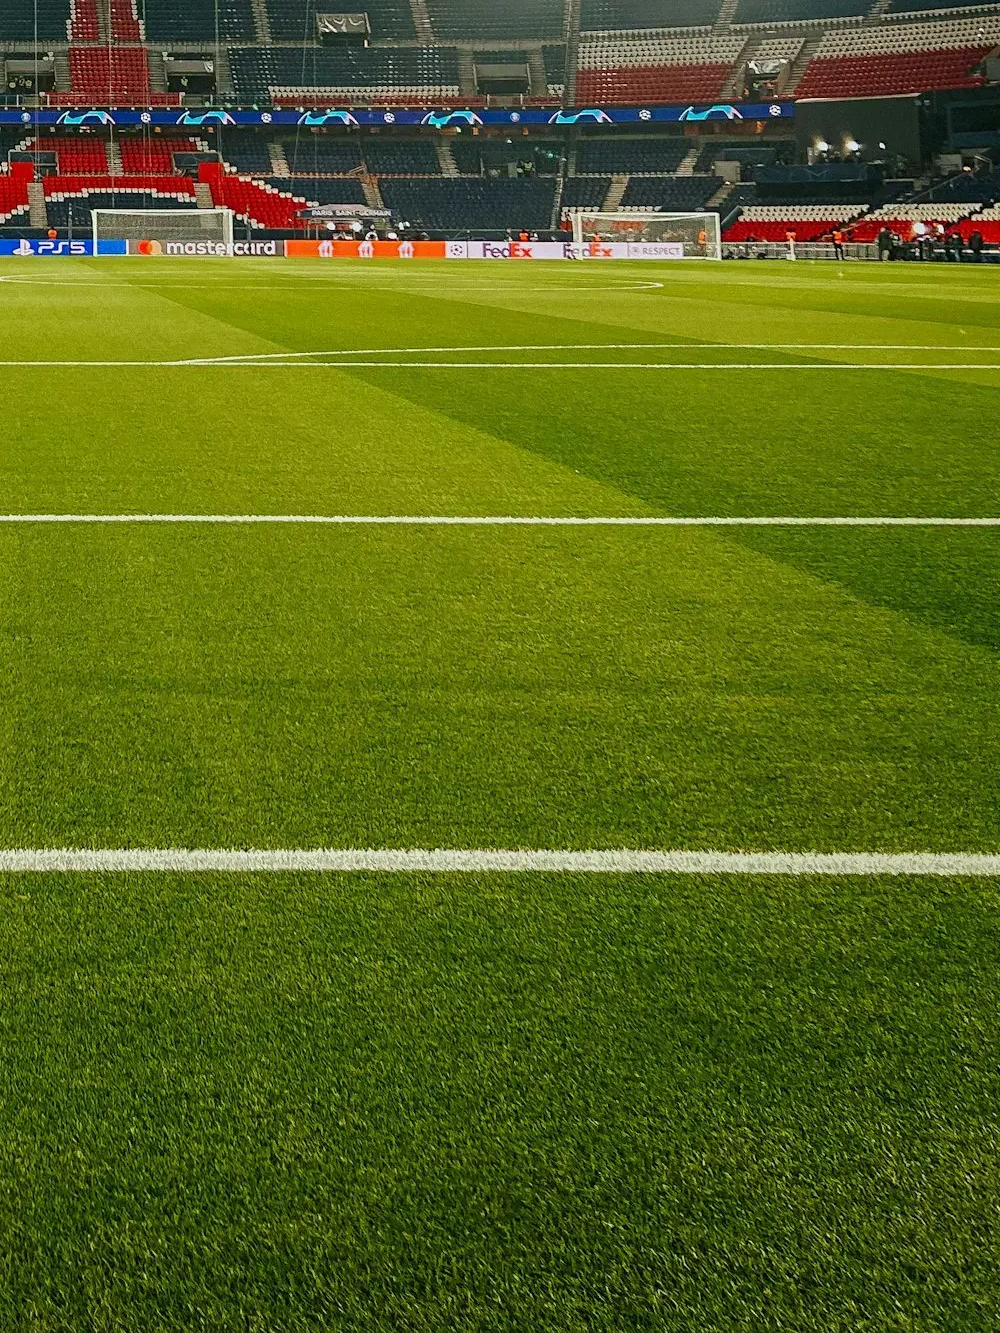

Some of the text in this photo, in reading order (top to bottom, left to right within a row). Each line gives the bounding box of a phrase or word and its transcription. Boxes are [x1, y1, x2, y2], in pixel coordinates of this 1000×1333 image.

[311, 209, 392, 217] PARIS SAINT-GERMAIN
[38, 241, 86, 255] PS5
[166, 240, 276, 256] mastercard
[482, 242, 532, 258] FedEx
[563, 242, 613, 258] FedEx
[642, 247, 680, 256] RESPECT
